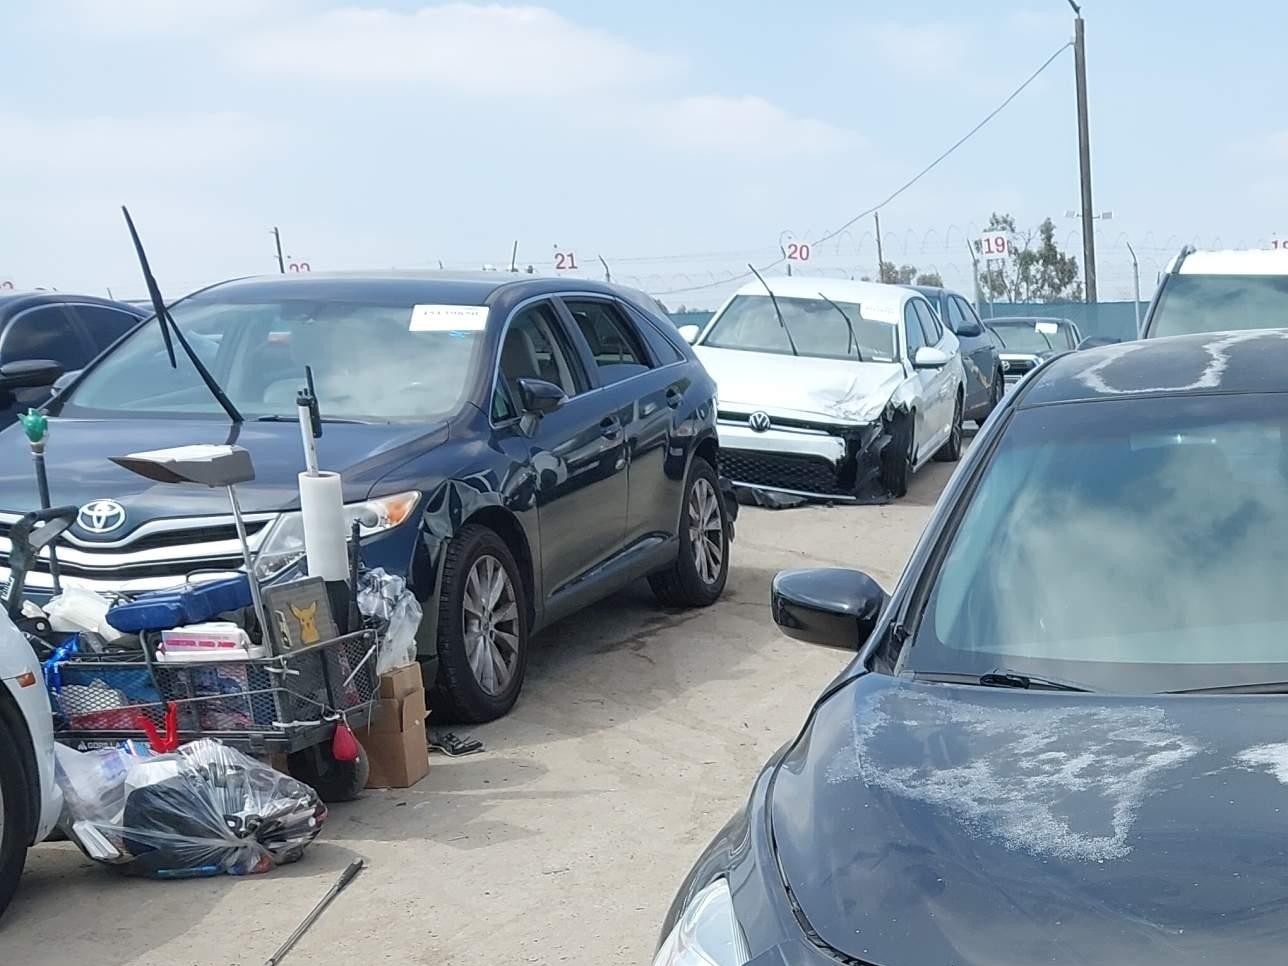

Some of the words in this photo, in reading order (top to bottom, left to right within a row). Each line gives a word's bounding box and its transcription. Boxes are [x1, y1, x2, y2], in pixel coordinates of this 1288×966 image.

[787, 244, 810, 261] 20
[984, 236, 1006, 255] 19
[555, 253, 578, 269] 21
